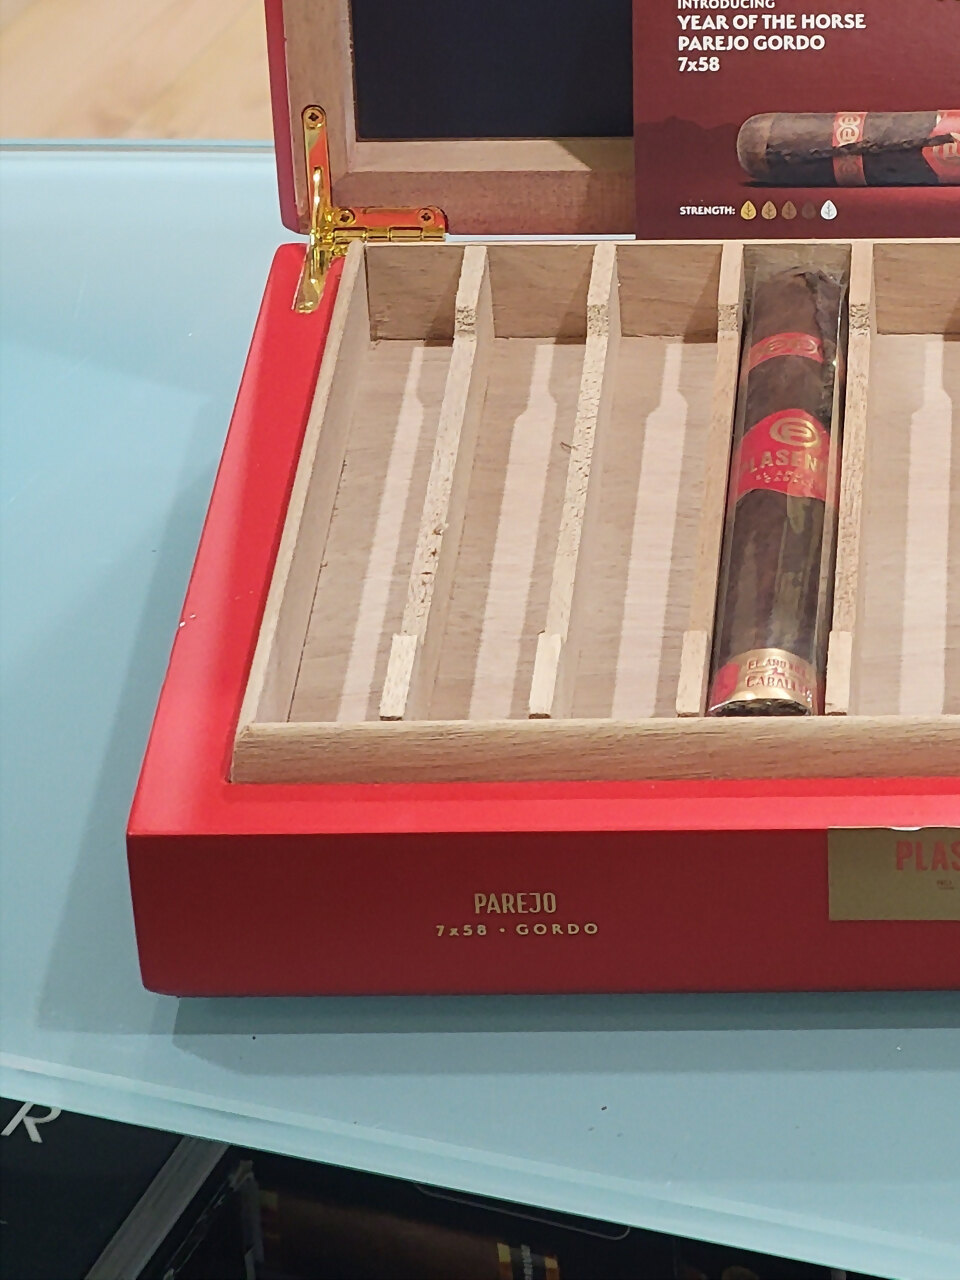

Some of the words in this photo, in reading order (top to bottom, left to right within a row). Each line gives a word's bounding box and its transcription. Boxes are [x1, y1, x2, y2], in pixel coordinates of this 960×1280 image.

[677, 15, 729, 30] YEAR
[732, 15, 758, 30] OF
[762, 14, 797, 29] THE
[801, 14, 866, 29] HORSE
[678, 36, 748, 51] PAREJO
[753, 35, 825, 50] GORDO
[677, 57, 720, 72] 7x58
[679, 206, 736, 216] STRENGTH:
[474, 892, 557, 914] PAREJO
[436, 924, 487, 937] 7x58
[515, 923, 598, 935] GORDO
